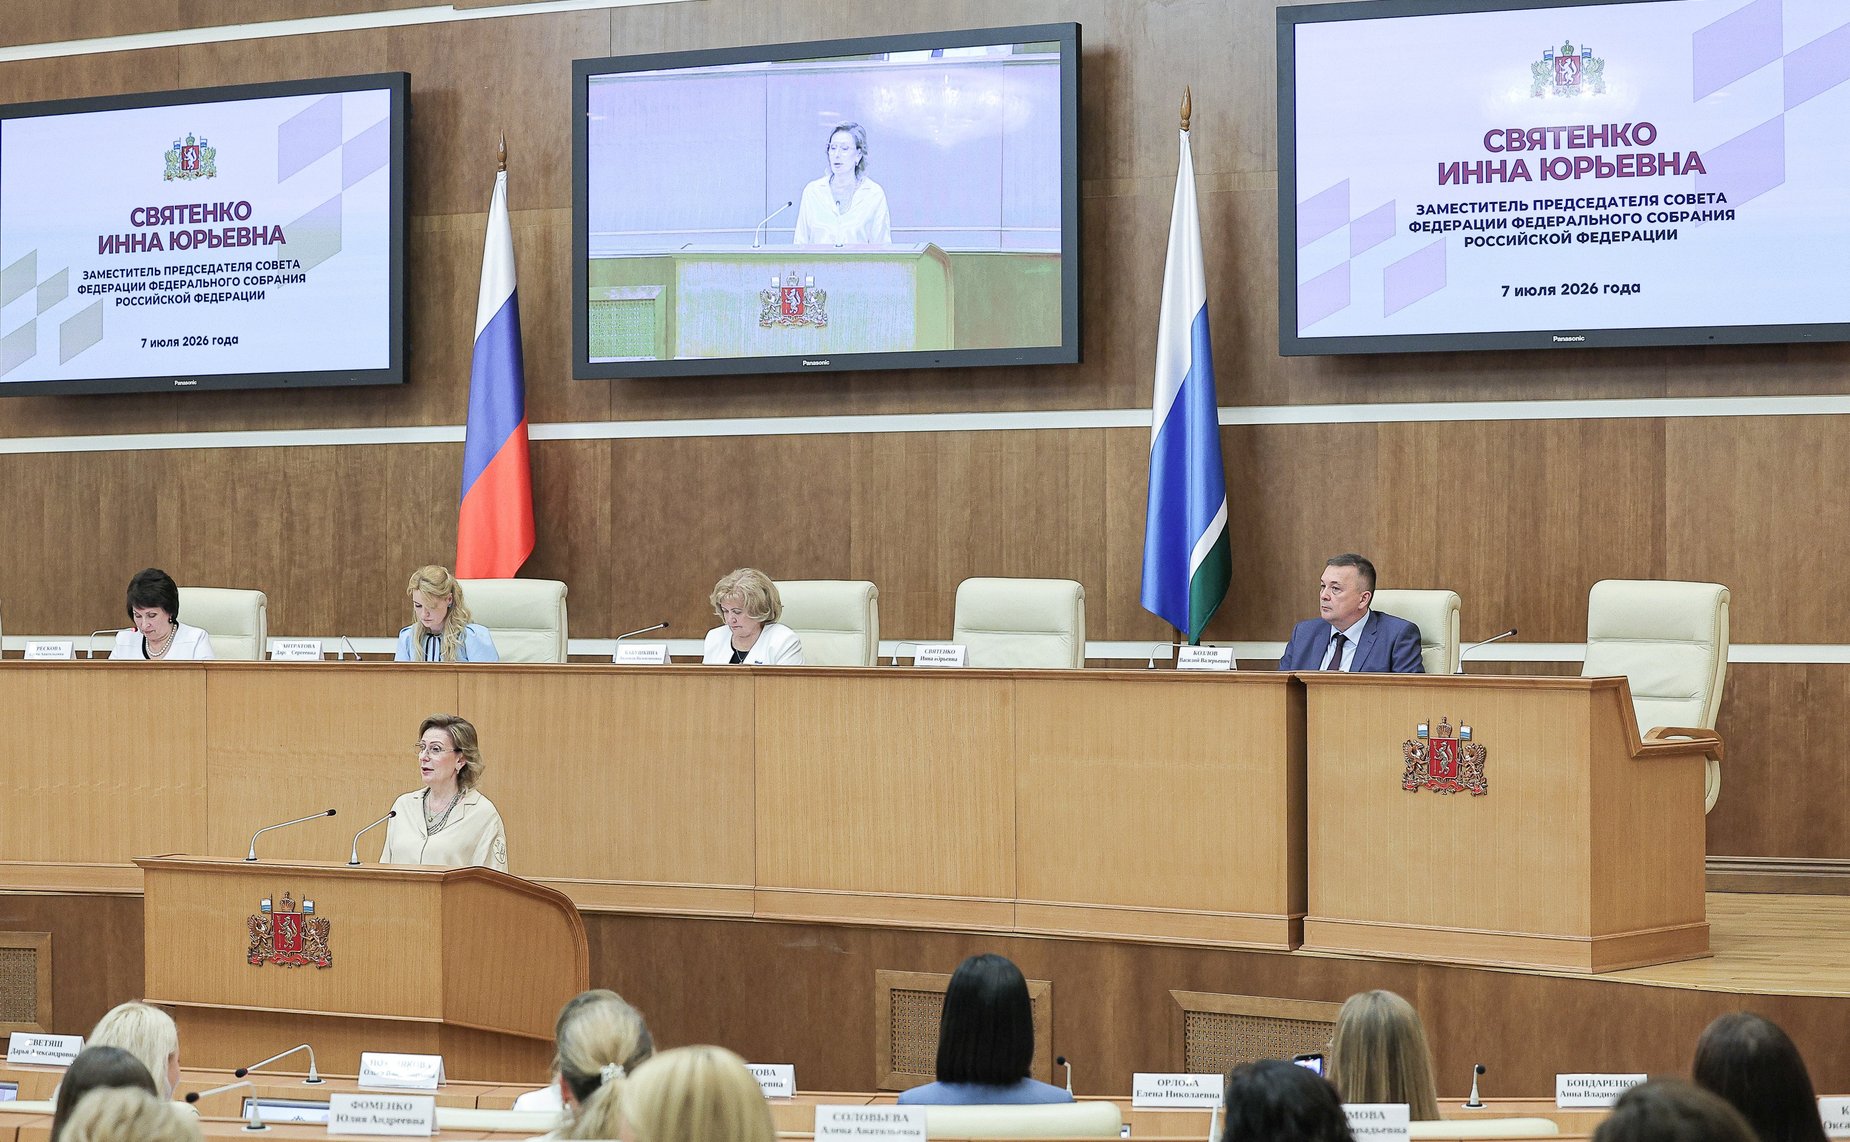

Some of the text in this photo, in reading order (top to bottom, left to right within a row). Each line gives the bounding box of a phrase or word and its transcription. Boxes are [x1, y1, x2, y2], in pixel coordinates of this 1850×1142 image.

[1483, 122, 1657, 152] СВЯТЕНКО
[1438, 151, 1706, 185] ИННА ЮРЬЕВНА
[1416, 193, 1727, 214] ЗАМЕСТИТЕЛЬ ПРЕДСЕДАТЕЛЯ СОВЕТА
[131, 201, 252, 227] СВЯТЕНКО
[1409, 209, 1735, 233] ФЕДЕРАЦИИ ФЕДЕРАЛЬНОГО СОБРАНИЯ
[98, 225, 286, 254] ИННА ЮРЬЕВНА
[1464, 229, 1678, 247] РОССИЙСКОЙ ФЕДЕРАЦИИ
[83, 260, 300, 280] ЗАМЕСТИТЕЛЬ ПРЕДСЕДАТЕЛЯ СОВЕТА
[77, 274, 306, 295] ФЕДЕРАЦИИ ФЕДЕРАЛЬНОГО СОБРАНИЯ
[1502, 282, 1641, 297] 7 июля 2026 года
[115, 291, 265, 307] РОССИЙСКОЙ ФЕДЕРАЦИИ
[141, 335, 239, 348] 7 июля 2026 года
[1567, 1079, 1638, 1088] БОНДАРЕНКО
[1165, 1090, 1220, 1099] Николаевна
[1560, 1090, 1619, 1099] Анна Владим
[351, 1101, 413, 1111] ФОМЕНКО
